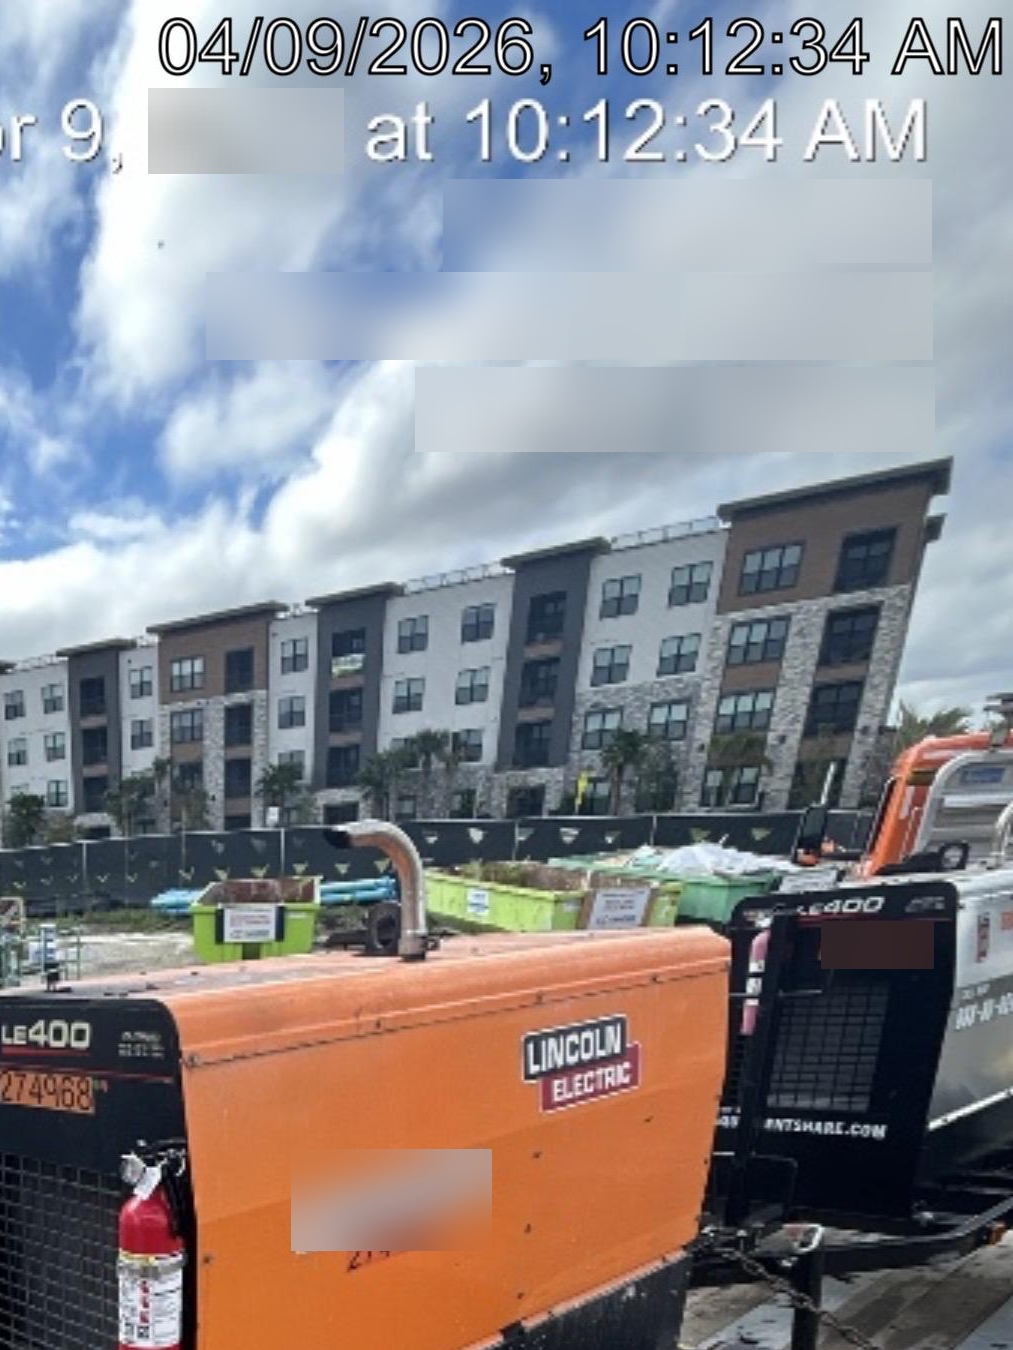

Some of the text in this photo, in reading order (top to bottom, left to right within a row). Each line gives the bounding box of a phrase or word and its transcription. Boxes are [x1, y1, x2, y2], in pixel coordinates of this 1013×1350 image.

[1, 1019, 91, 1050] LE400
[527, 1022, 622, 1075] LINCOLN
[552, 1061, 631, 1102] ELECTRIC
